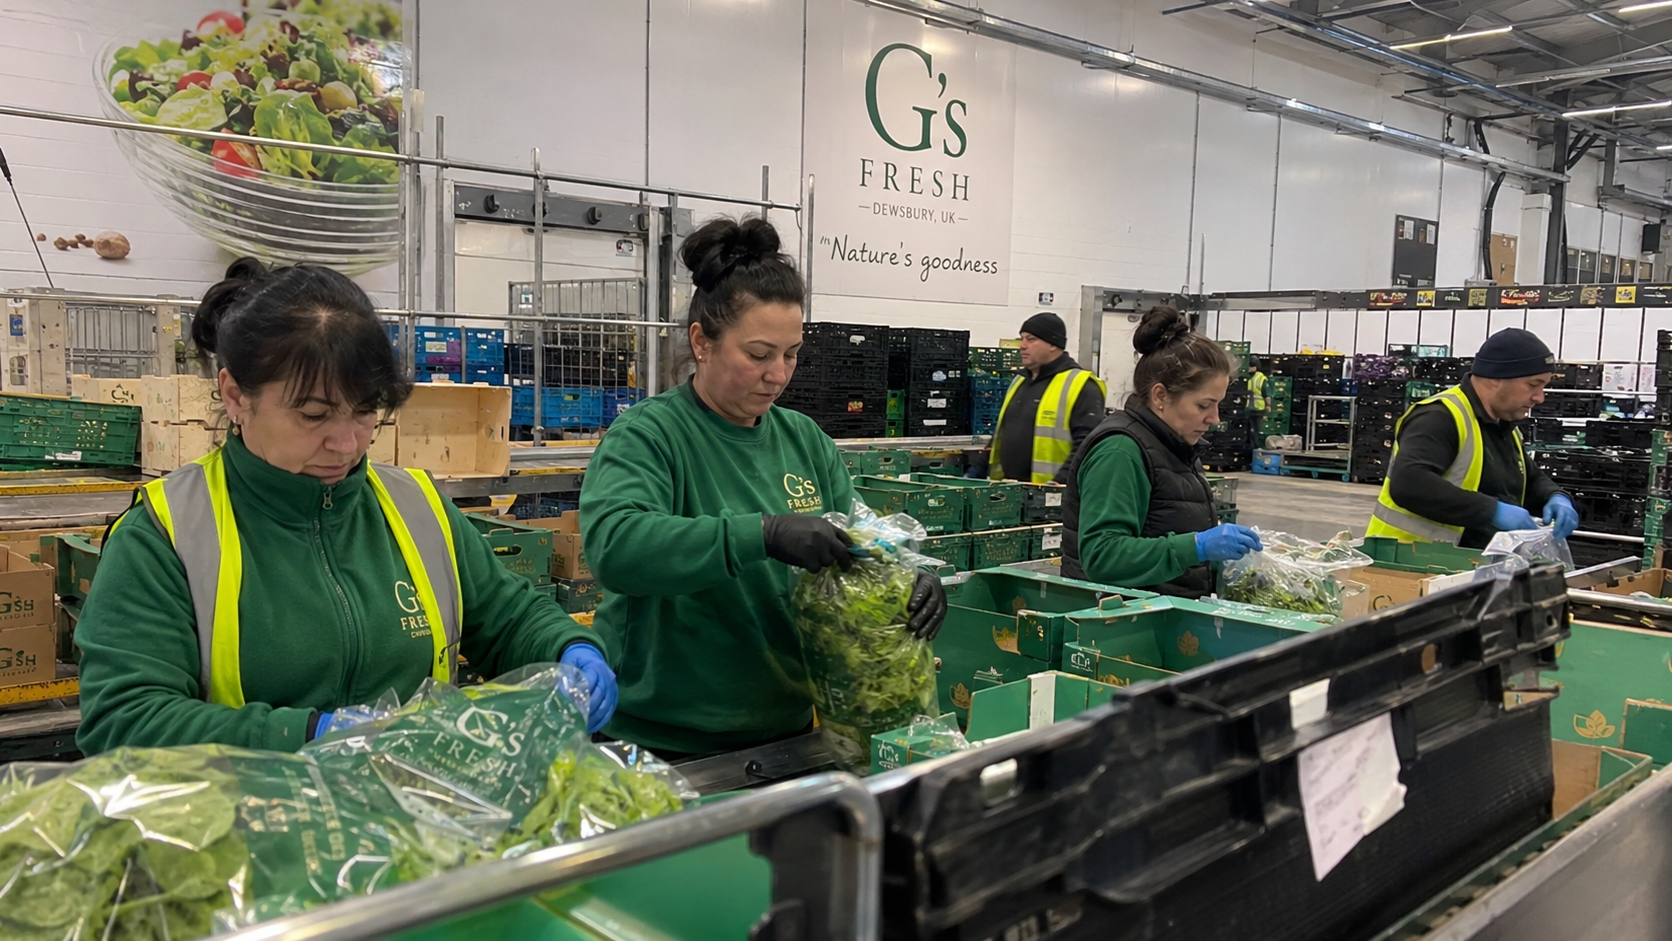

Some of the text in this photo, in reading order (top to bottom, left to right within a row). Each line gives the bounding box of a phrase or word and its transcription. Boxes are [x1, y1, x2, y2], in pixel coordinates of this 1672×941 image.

[859, 157, 970, 201] FRESH
[873, 202, 956, 224] DEWSBURY, UK
[921, 247, 998, 282] goodness
[787, 496, 822, 509] FRESH
[400, 615, 431, 630] FRES
[433, 732, 518, 778] FRESH
